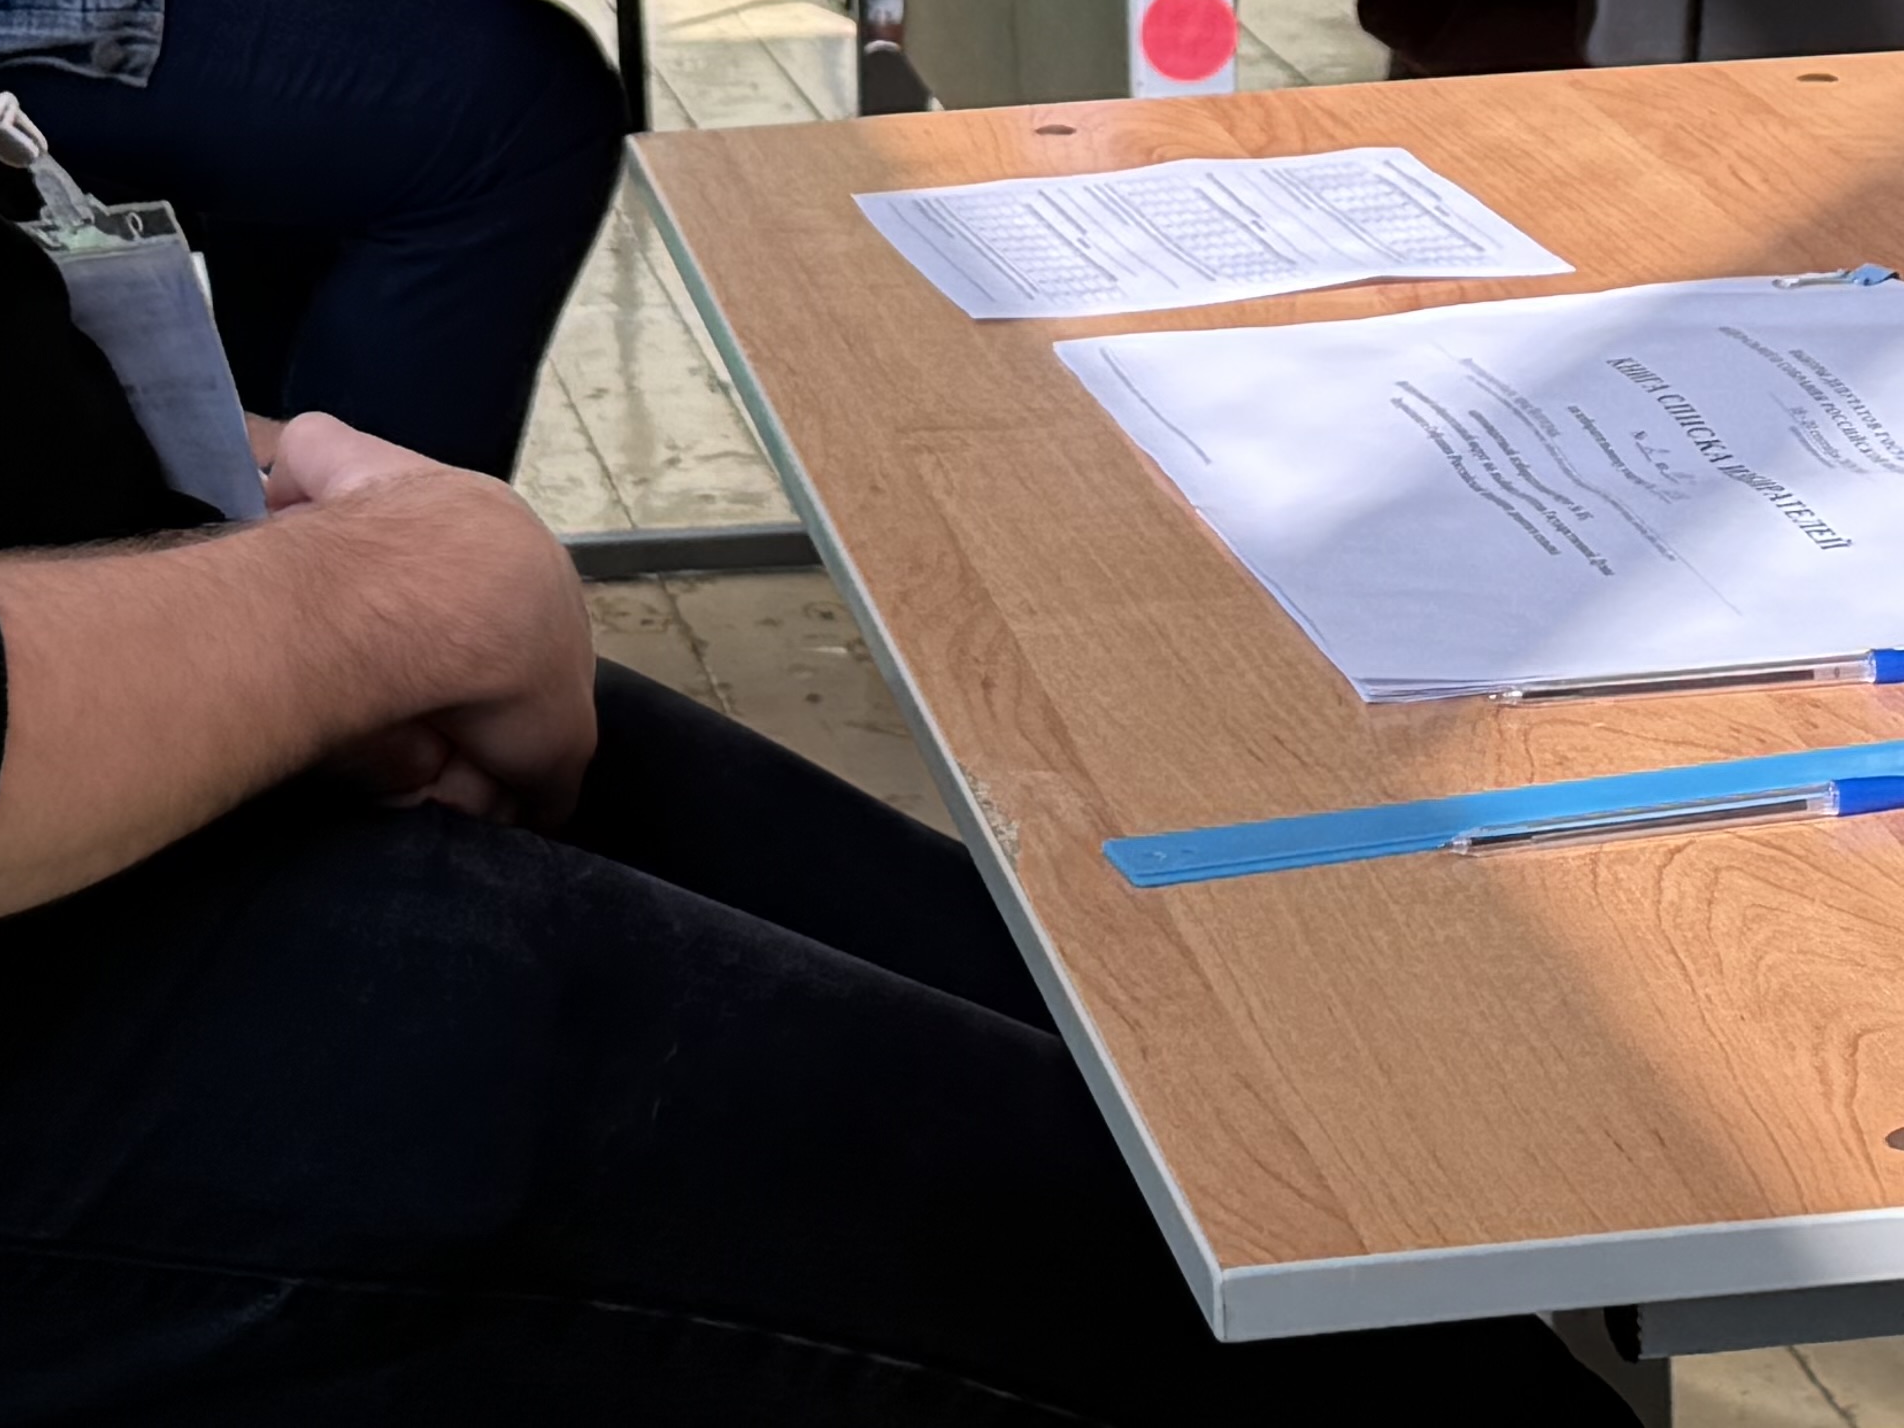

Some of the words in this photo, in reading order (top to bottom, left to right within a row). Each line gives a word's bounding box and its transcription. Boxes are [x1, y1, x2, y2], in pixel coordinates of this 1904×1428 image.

[1606, 357, 1670, 393] КНИГА
[1652, 393, 1732, 463] СПИСКА
[1717, 465, 1853, 550] ИЗБИРАТЕЛЕЙ
